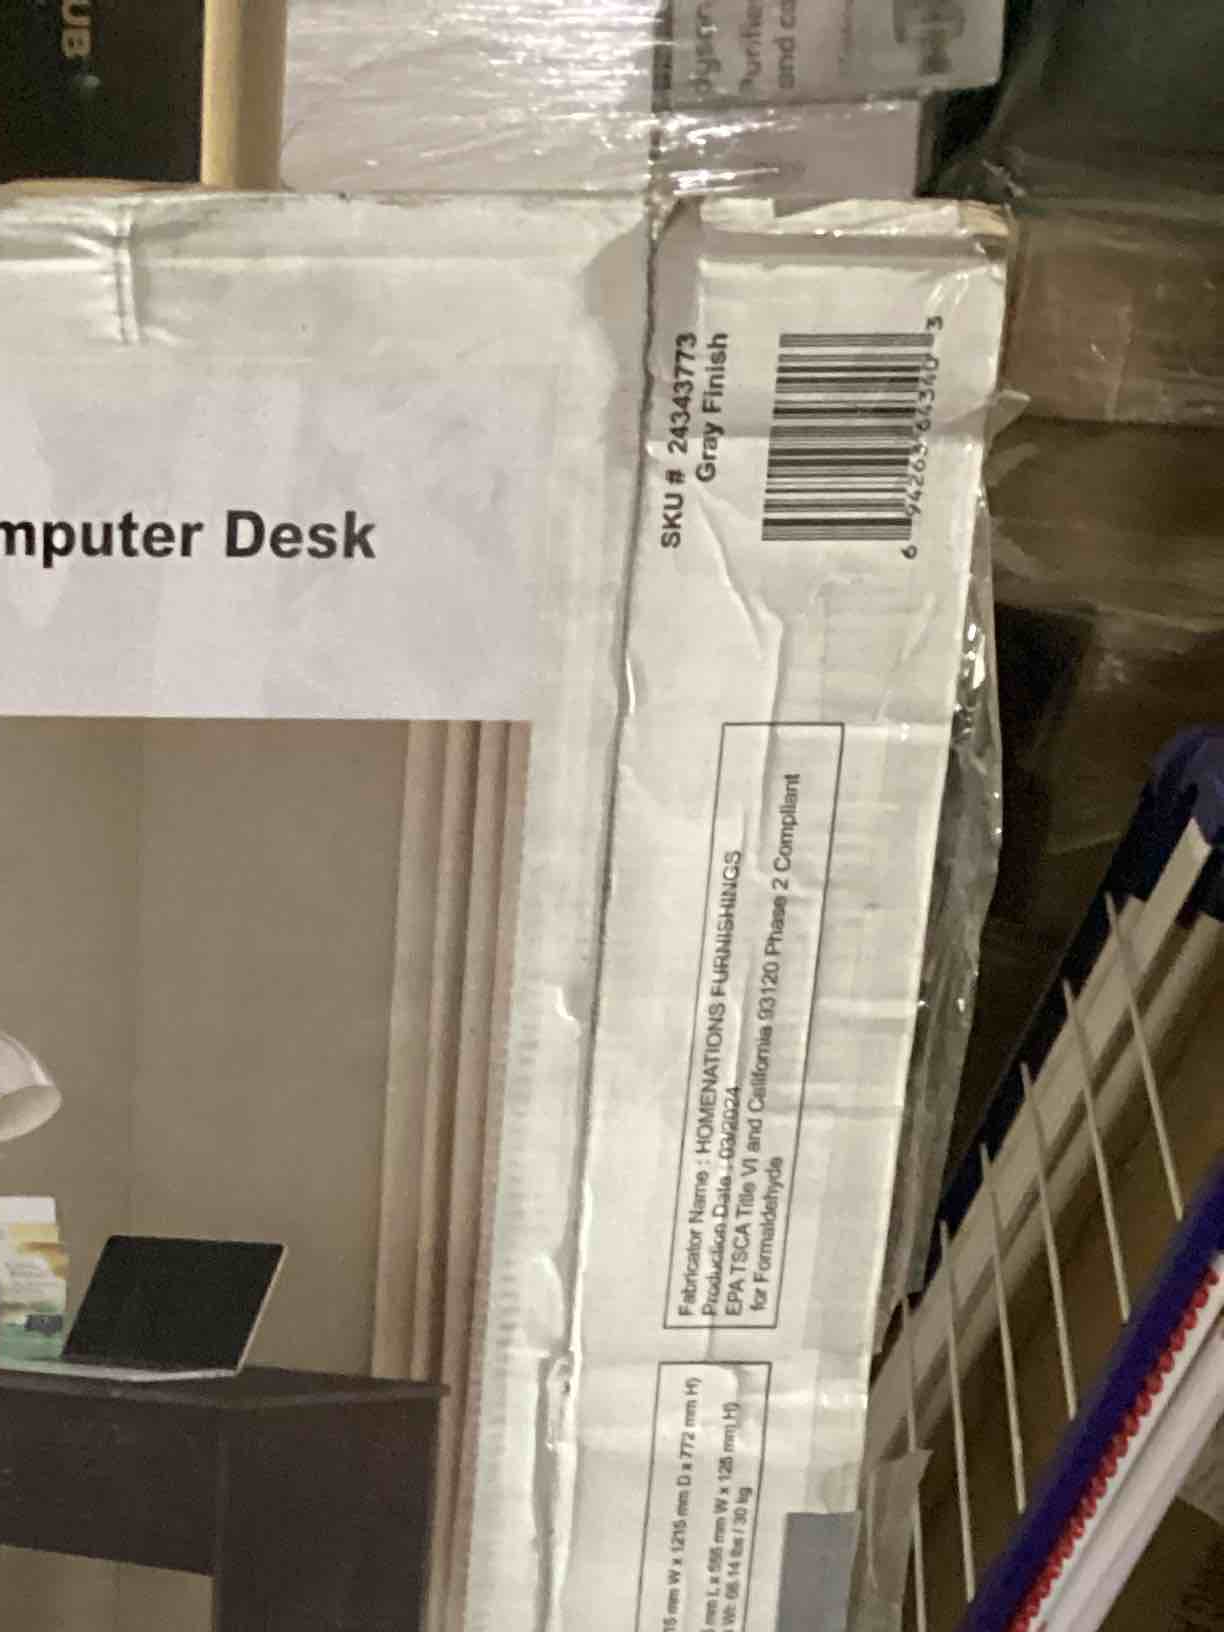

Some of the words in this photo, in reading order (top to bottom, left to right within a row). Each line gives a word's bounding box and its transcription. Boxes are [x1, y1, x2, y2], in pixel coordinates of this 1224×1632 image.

[667, 332, 697, 454] 24343773
[701, 332, 729, 413] Finish
[665, 469, 685, 485] #
[695, 422, 724, 482] Gray
[225, 510, 377, 560] Desk
[661, 494, 683, 550] SKU
[772, 771, 802, 872] Compliant
[771, 877, 788, 890] 2
[709, 848, 742, 997] FURNISHINGS
[764, 895, 787, 955] Phase
[757, 961, 780, 1021] 93120
[694, 1002, 726, 1154] HOMENATIONS
[747, 1024, 773, 1113] California
[743, 1117, 762, 1153] and
[687, 1169, 708, 1223] Name
[741, 1157, 758, 1176] VI
[730, 1222, 751, 1276] TSCA
[753, 1155, 786, 1283] Formaldehyde
[677, 1227, 703, 1317] Fabricator
[726, 1277, 745, 1315] EPA
[750, 1287, 767, 1311] for
